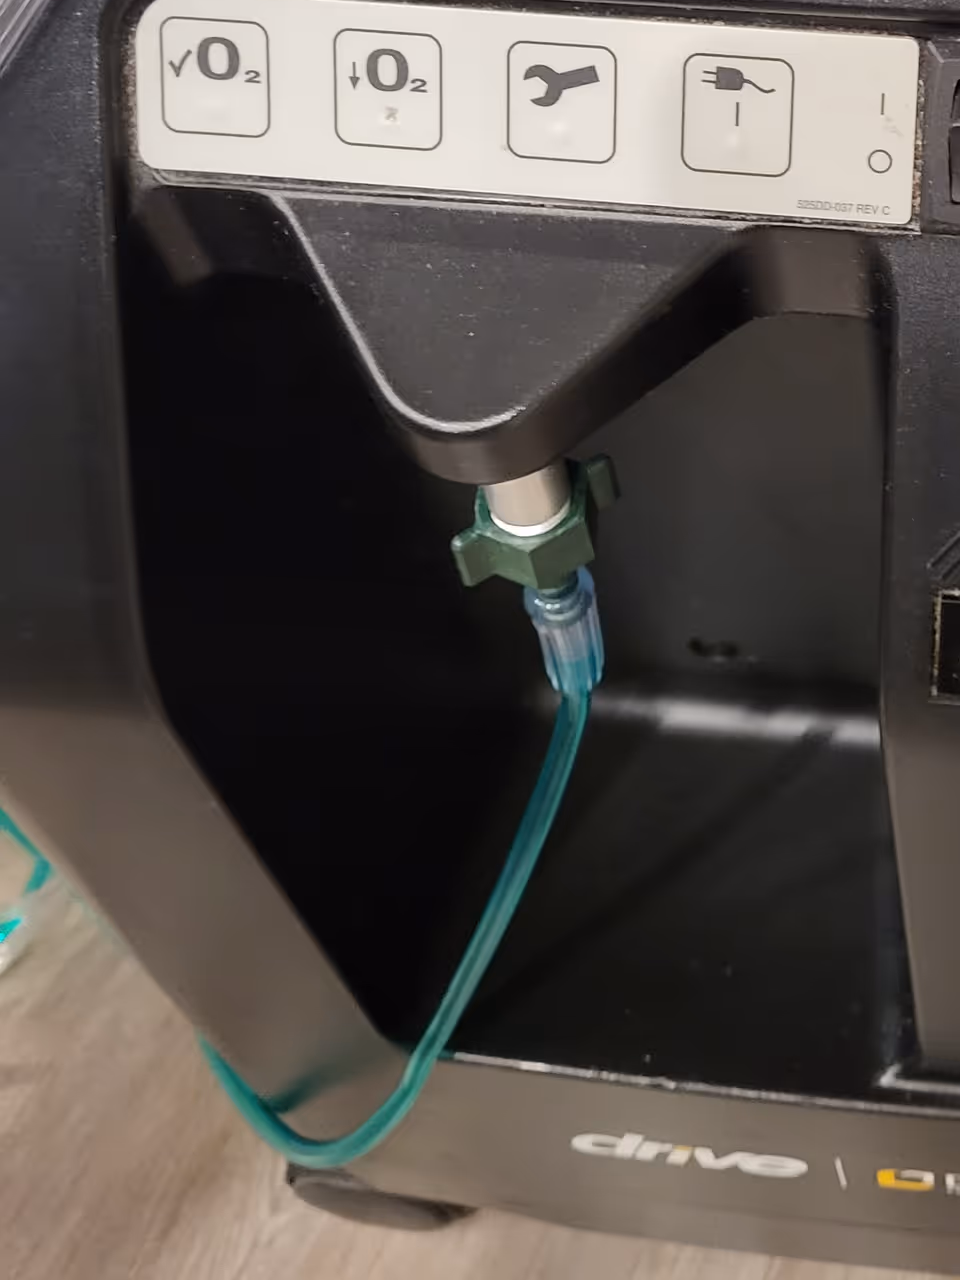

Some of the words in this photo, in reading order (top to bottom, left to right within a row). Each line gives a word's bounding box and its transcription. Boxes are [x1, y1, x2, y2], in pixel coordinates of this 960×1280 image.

[856, 204, 880, 215] REV
[881, 205, 891, 216] C
[571, 1131, 809, 1178] drive
